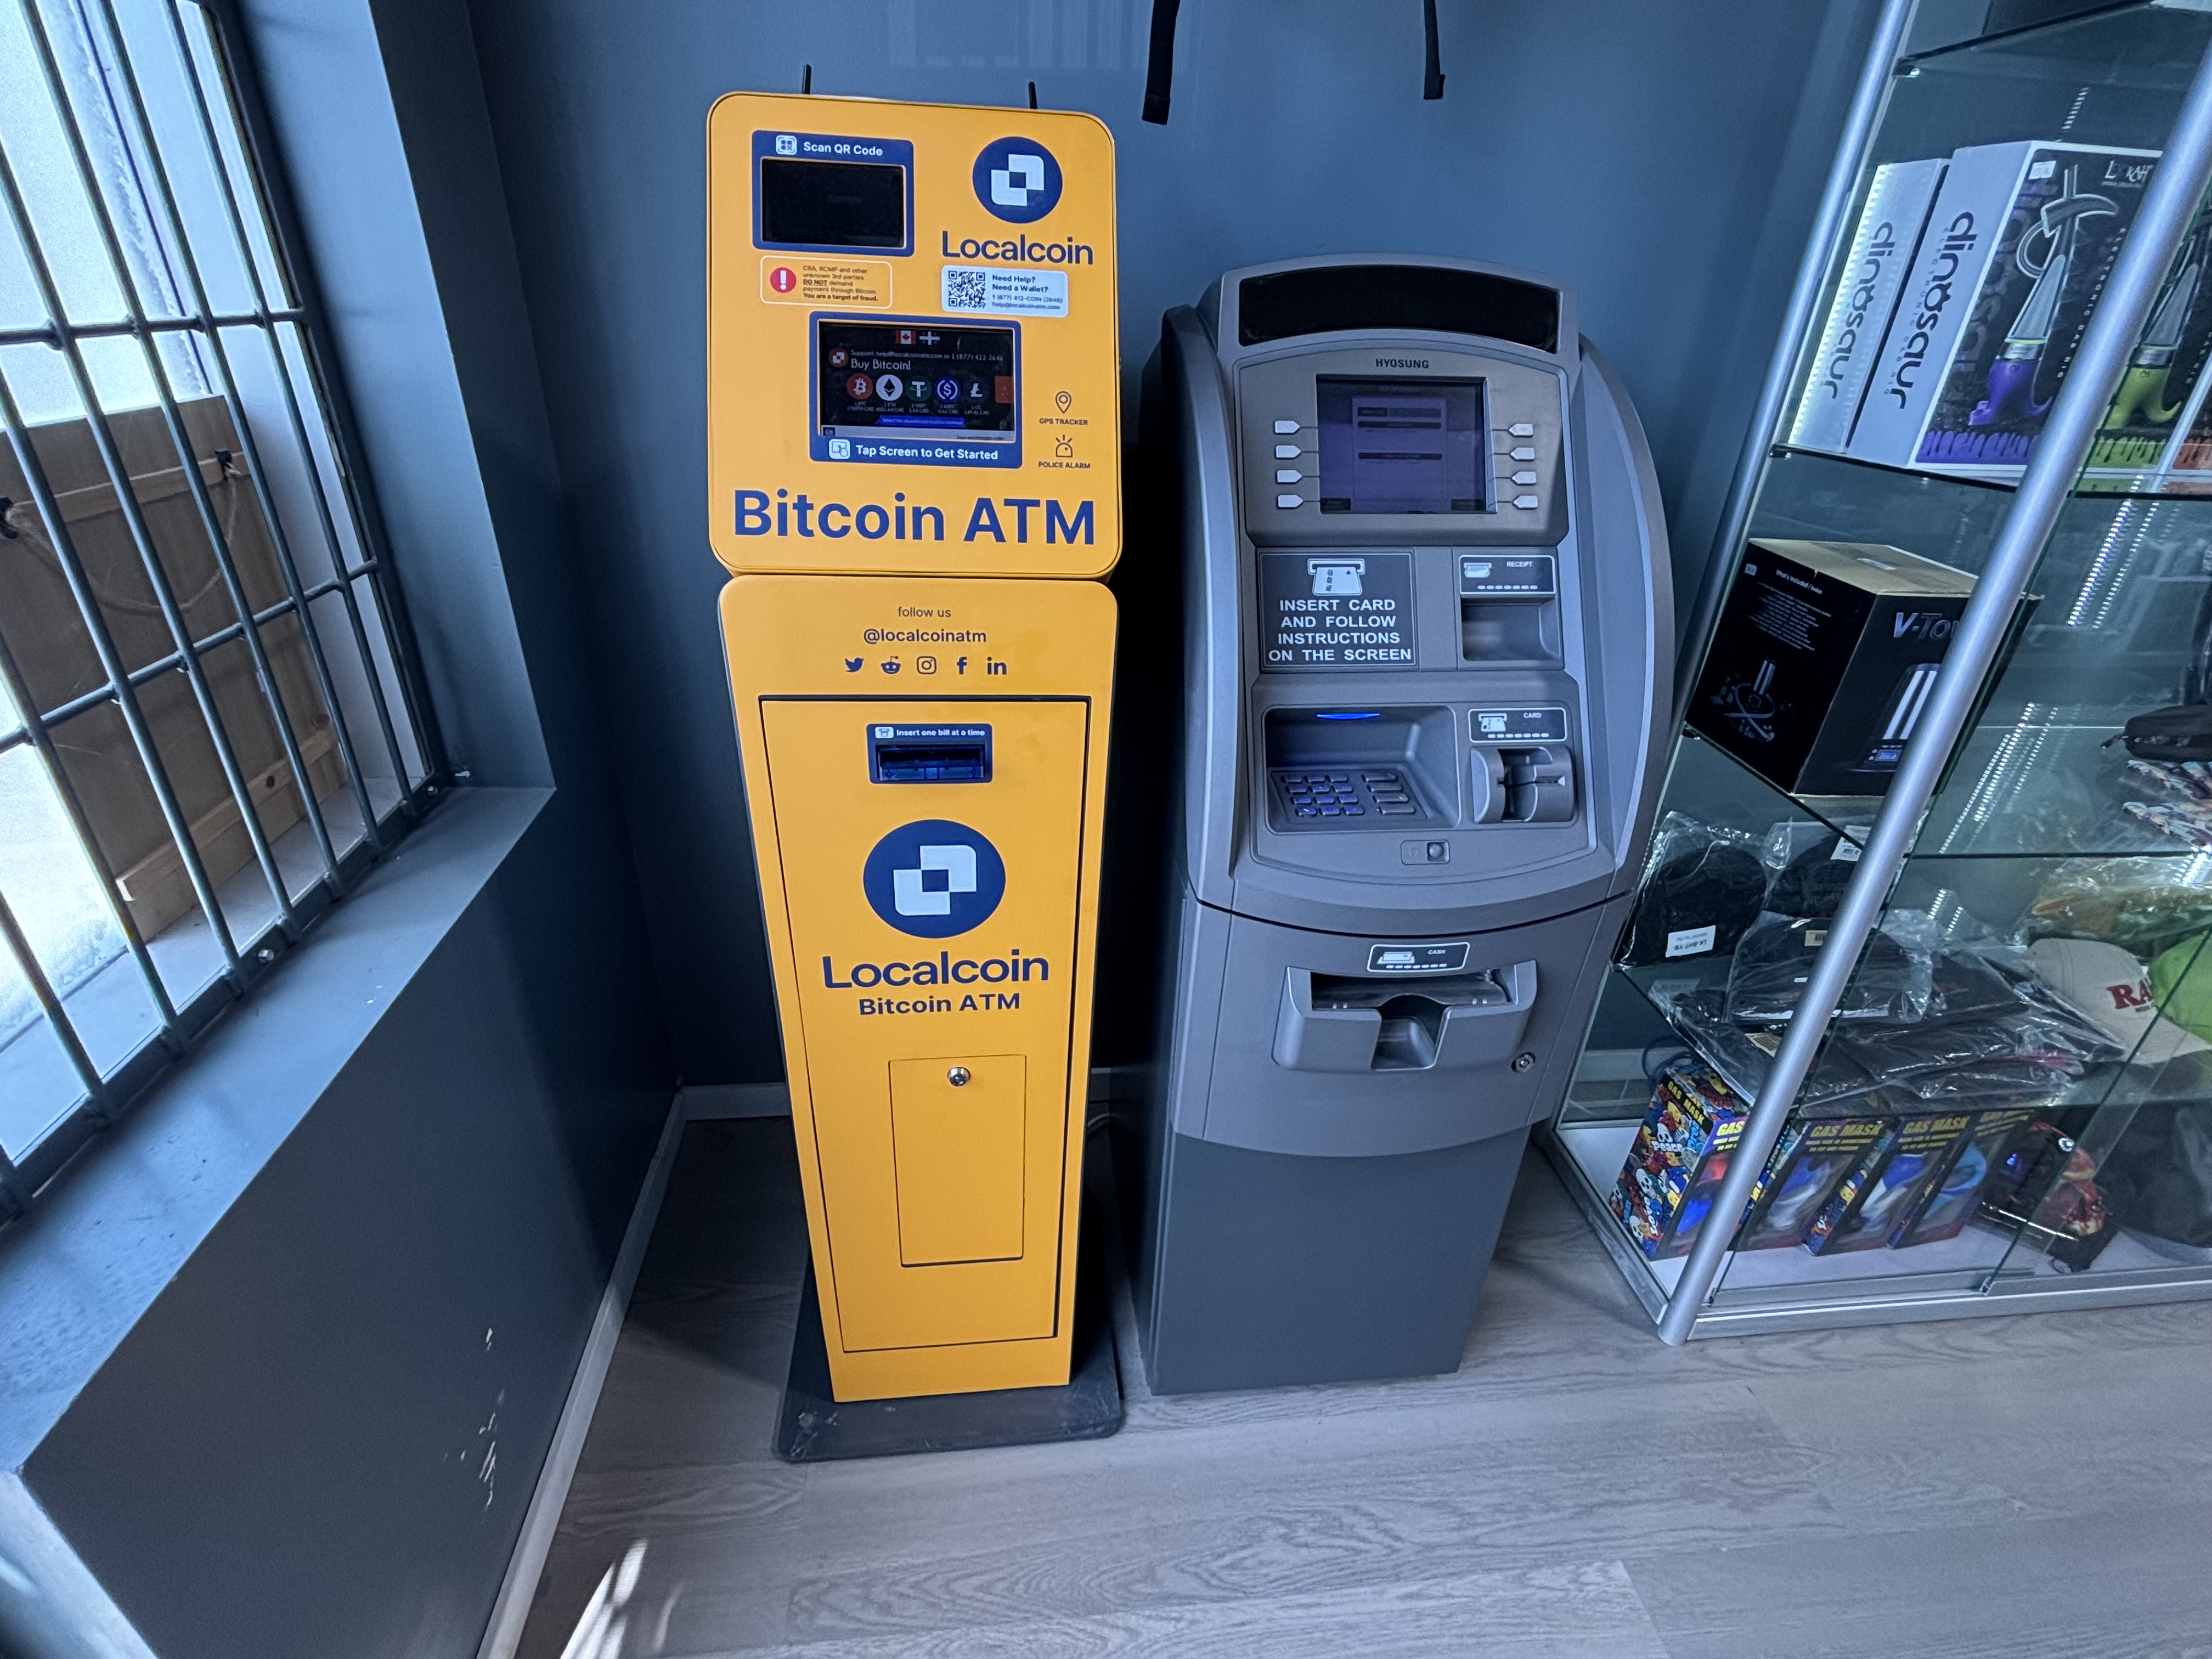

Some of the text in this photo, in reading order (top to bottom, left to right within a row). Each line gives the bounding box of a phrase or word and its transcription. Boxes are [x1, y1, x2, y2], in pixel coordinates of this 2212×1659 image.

[804, 142, 883, 156] Scan QR Code
[943, 230, 1093, 265] Localcoin
[1014, 275, 1036, 284] Help?
[1889, 211, 1977, 409] dinosaur
[851, 358, 870, 371] Buy
[1376, 358, 1429, 369] HYOSUNG
[856, 445, 998, 460] Tap Screen to Get Started
[734, 488, 1094, 545] Bitcoin ATM
[898, 606, 951, 618] follow us
[1280, 599, 1396, 611] INSERT CARD
[1281, 616, 1396, 628] AND FOLLOW
[864, 629, 987, 644] @localcoinatm
[1278, 632, 1400, 645] INSTRUCTIONS
[1268, 648, 1411, 662] ON THE SCREEN
[823, 949, 1049, 989] Localcoin
[2107, 974, 2153, 1009] RA
[859, 993, 1020, 1015] Bitcoin ATM
[1668, 1081, 1705, 1125] GAS MASK
[1716, 1120, 1746, 1137] GAS
[1810, 1124, 1885, 1137] GAS MASK
[1902, 1121, 1932, 1134] GAS
[1929, 1116, 1971, 1132] MASK
